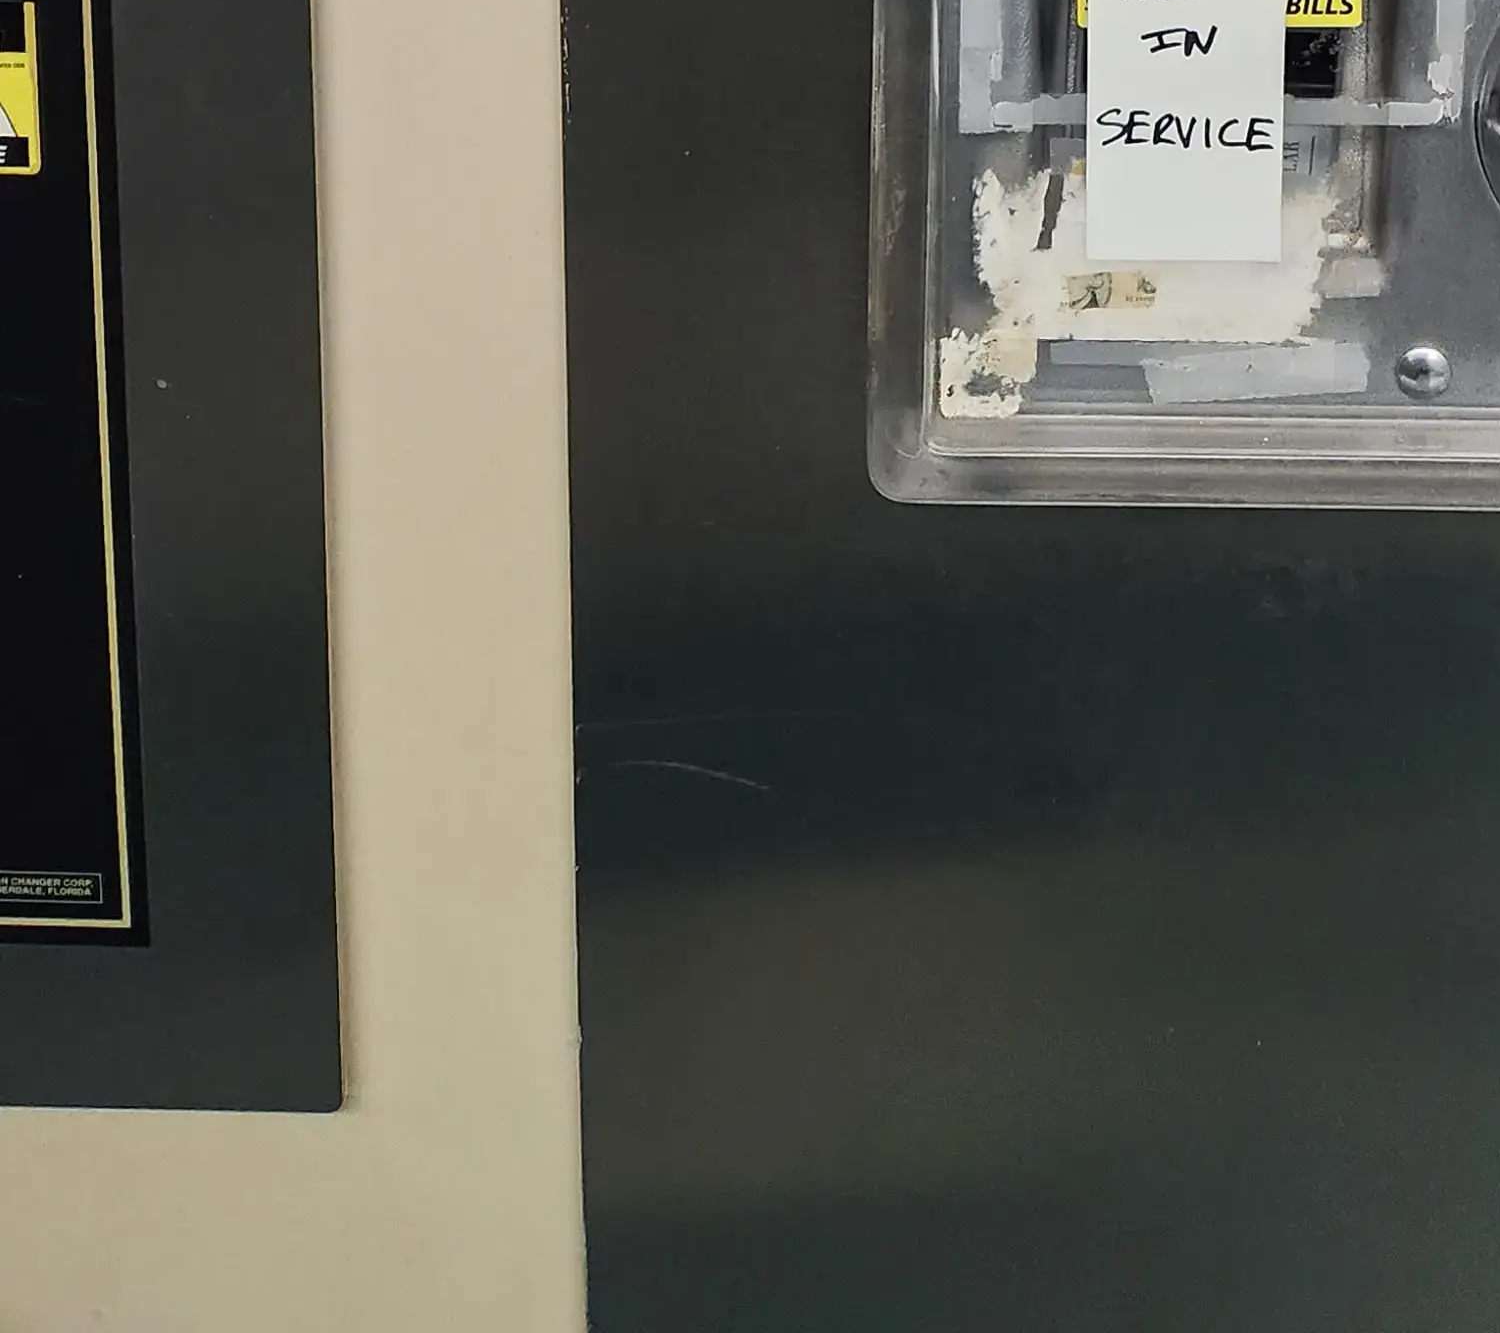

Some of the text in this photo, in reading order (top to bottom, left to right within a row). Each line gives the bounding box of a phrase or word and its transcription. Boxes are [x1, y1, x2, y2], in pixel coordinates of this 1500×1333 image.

[1140, 24, 1218, 57] IN
[1095, 107, 1276, 152] SERVICE
[11, 877, 61, 887] CHANGER
